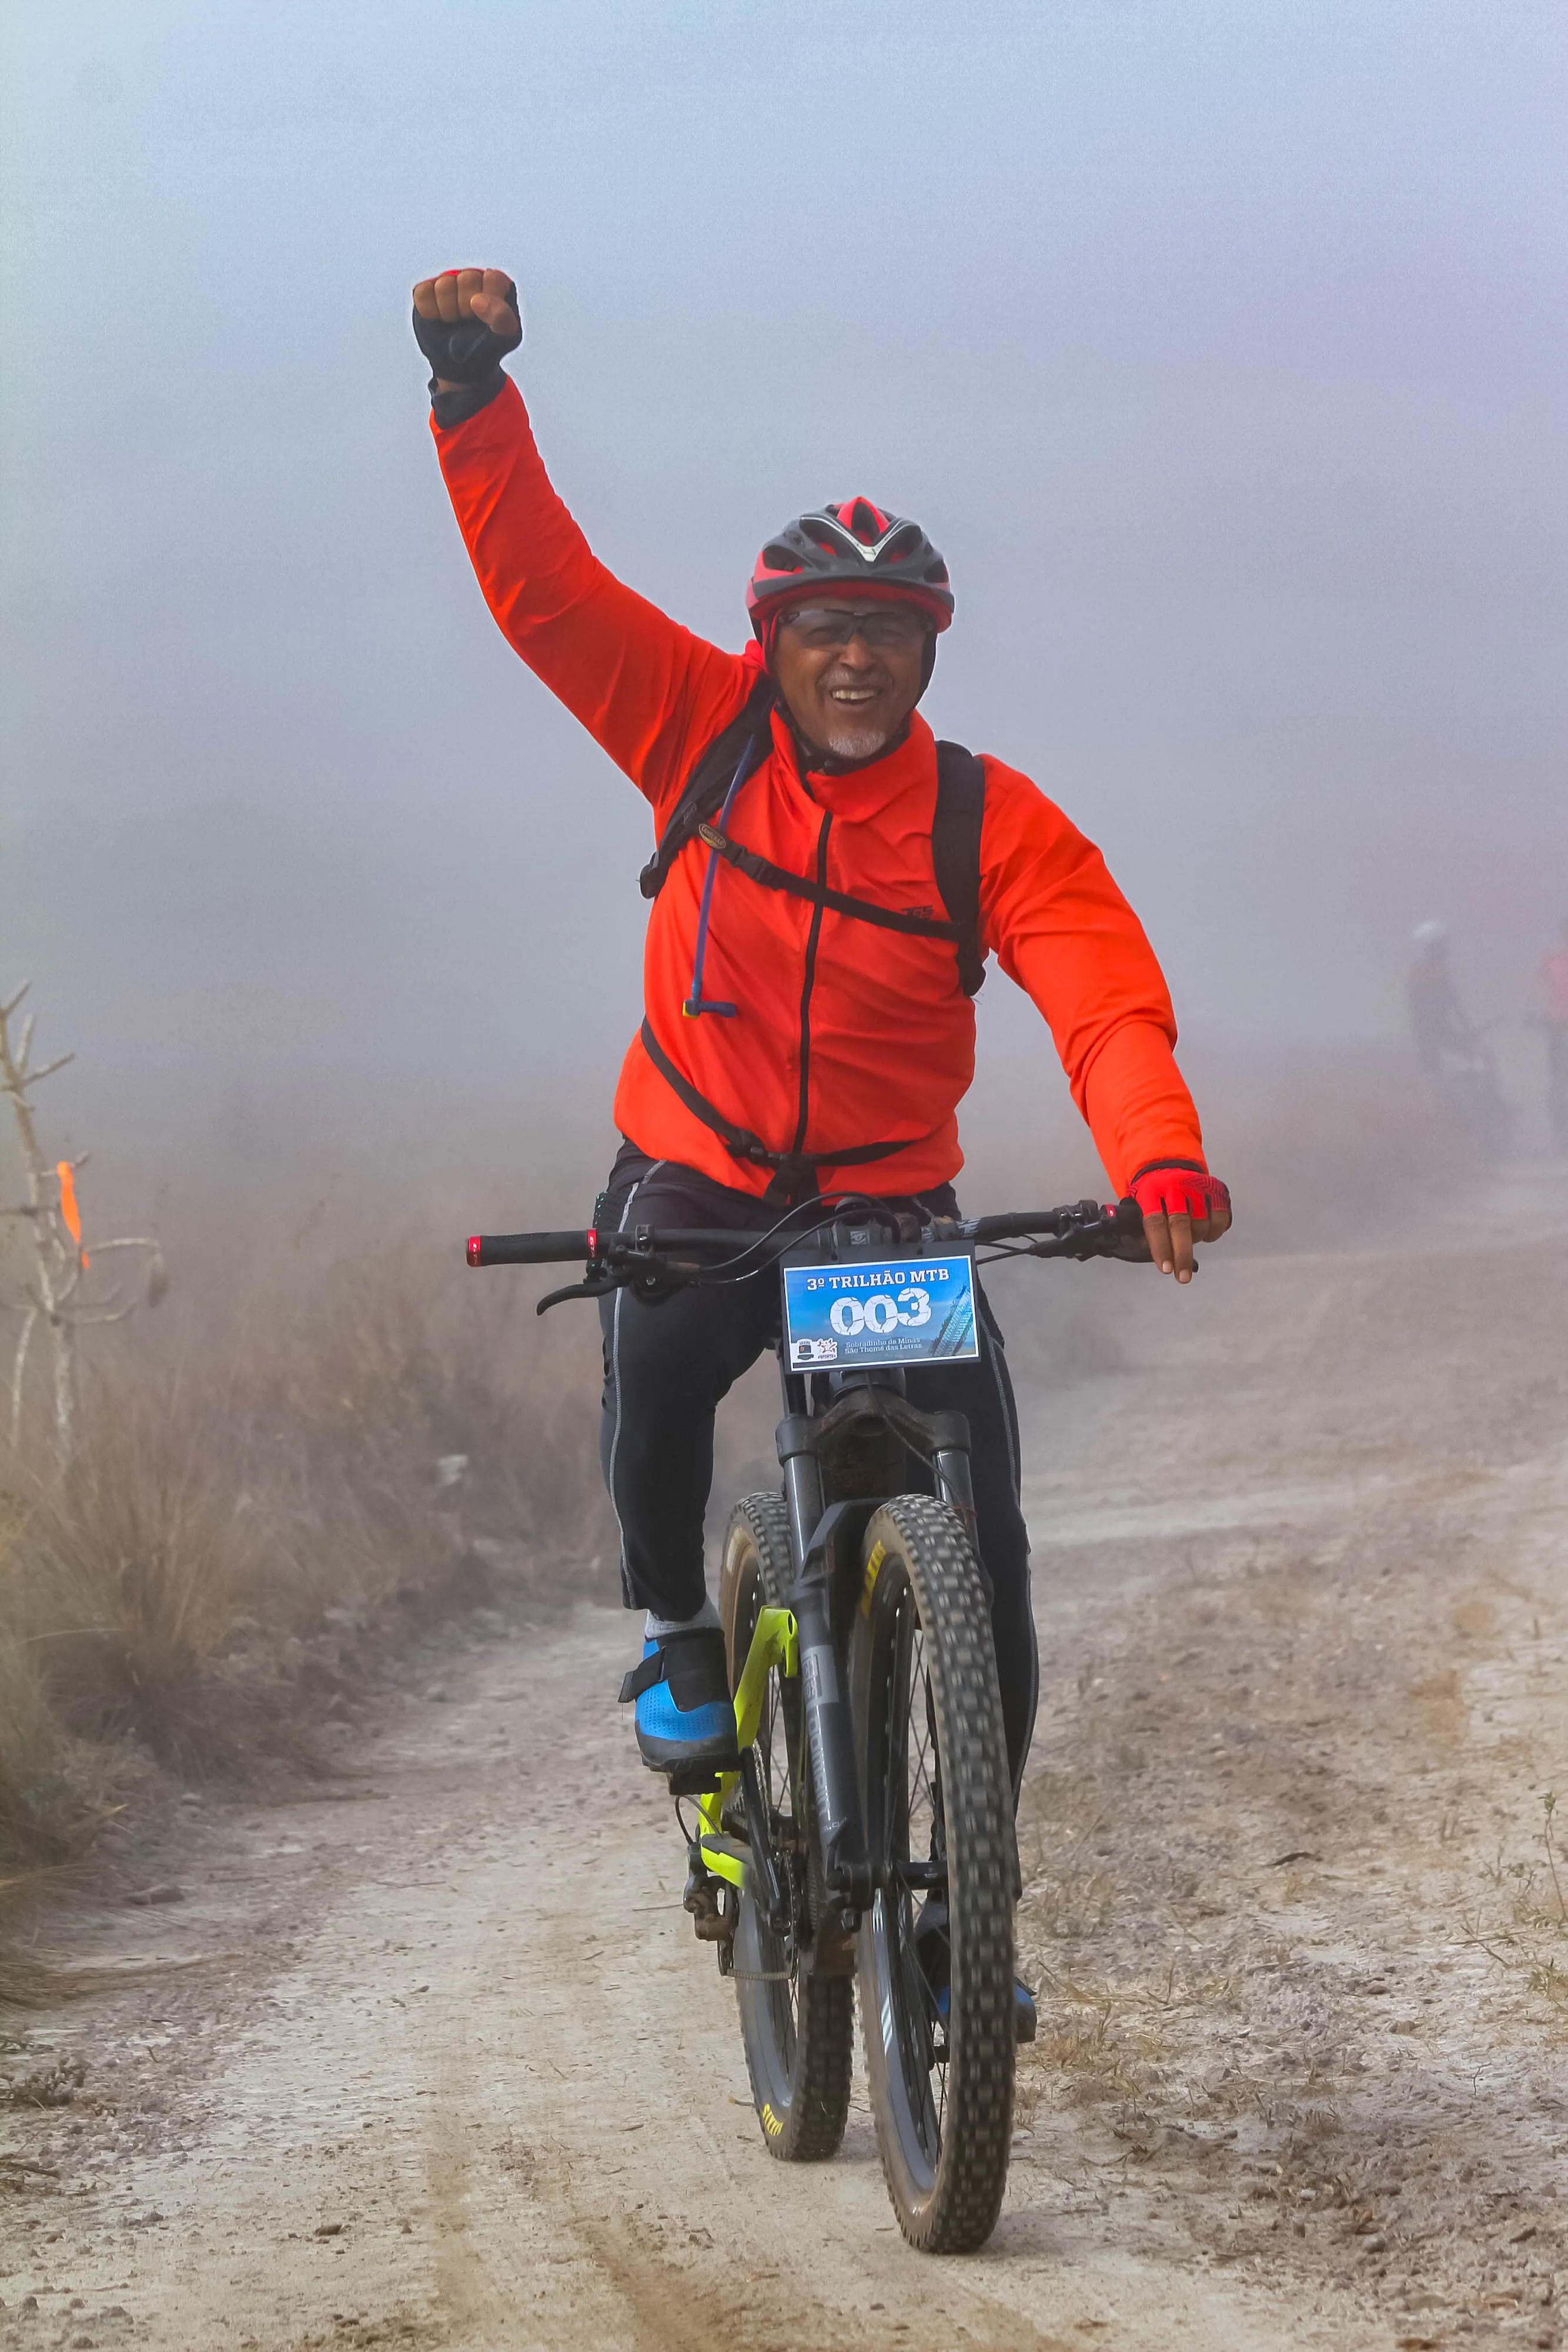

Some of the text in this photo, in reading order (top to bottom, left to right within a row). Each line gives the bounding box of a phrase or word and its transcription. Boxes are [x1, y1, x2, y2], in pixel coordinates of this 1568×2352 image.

[806, 1268, 950, 1291] 3º TRILHÃO MTB
[830, 1287, 932, 1336] 003
[846, 1339, 887, 1348] Sobradinho
[859, 1345, 884, 1353] Thomé
